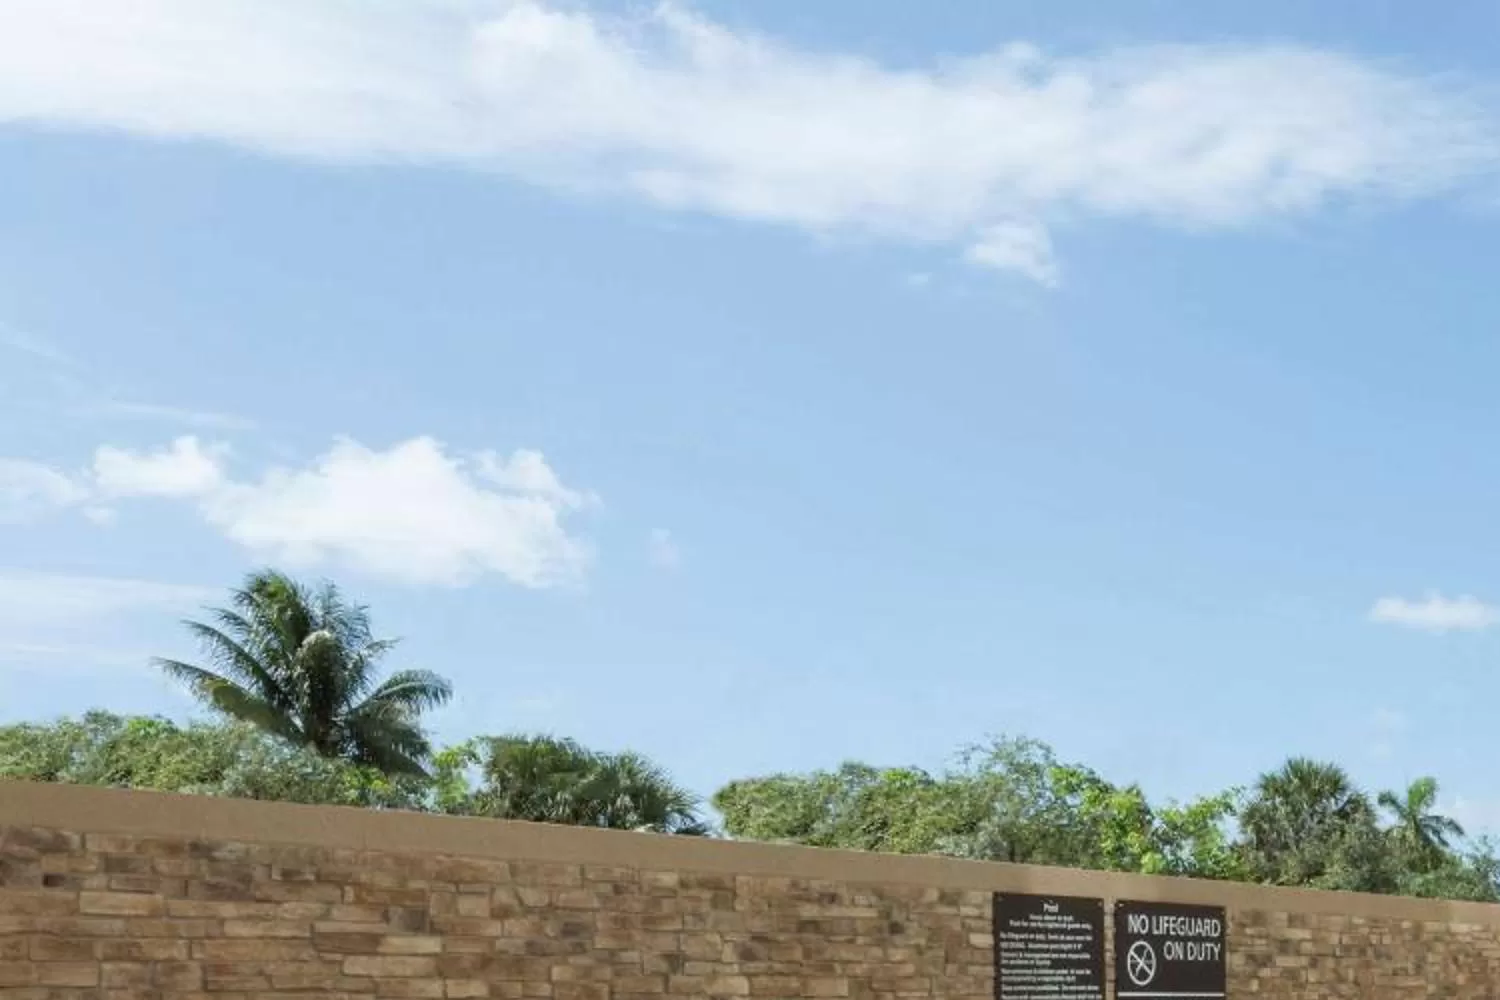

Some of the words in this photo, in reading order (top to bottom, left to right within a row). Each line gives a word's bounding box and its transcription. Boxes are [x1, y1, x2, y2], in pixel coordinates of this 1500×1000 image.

[1128, 914, 1149, 934] NO
[1152, 916, 1221, 937] LIFEGUARD
[1163, 941, 1184, 960] ON
[1187, 942, 1221, 961] DUTY
